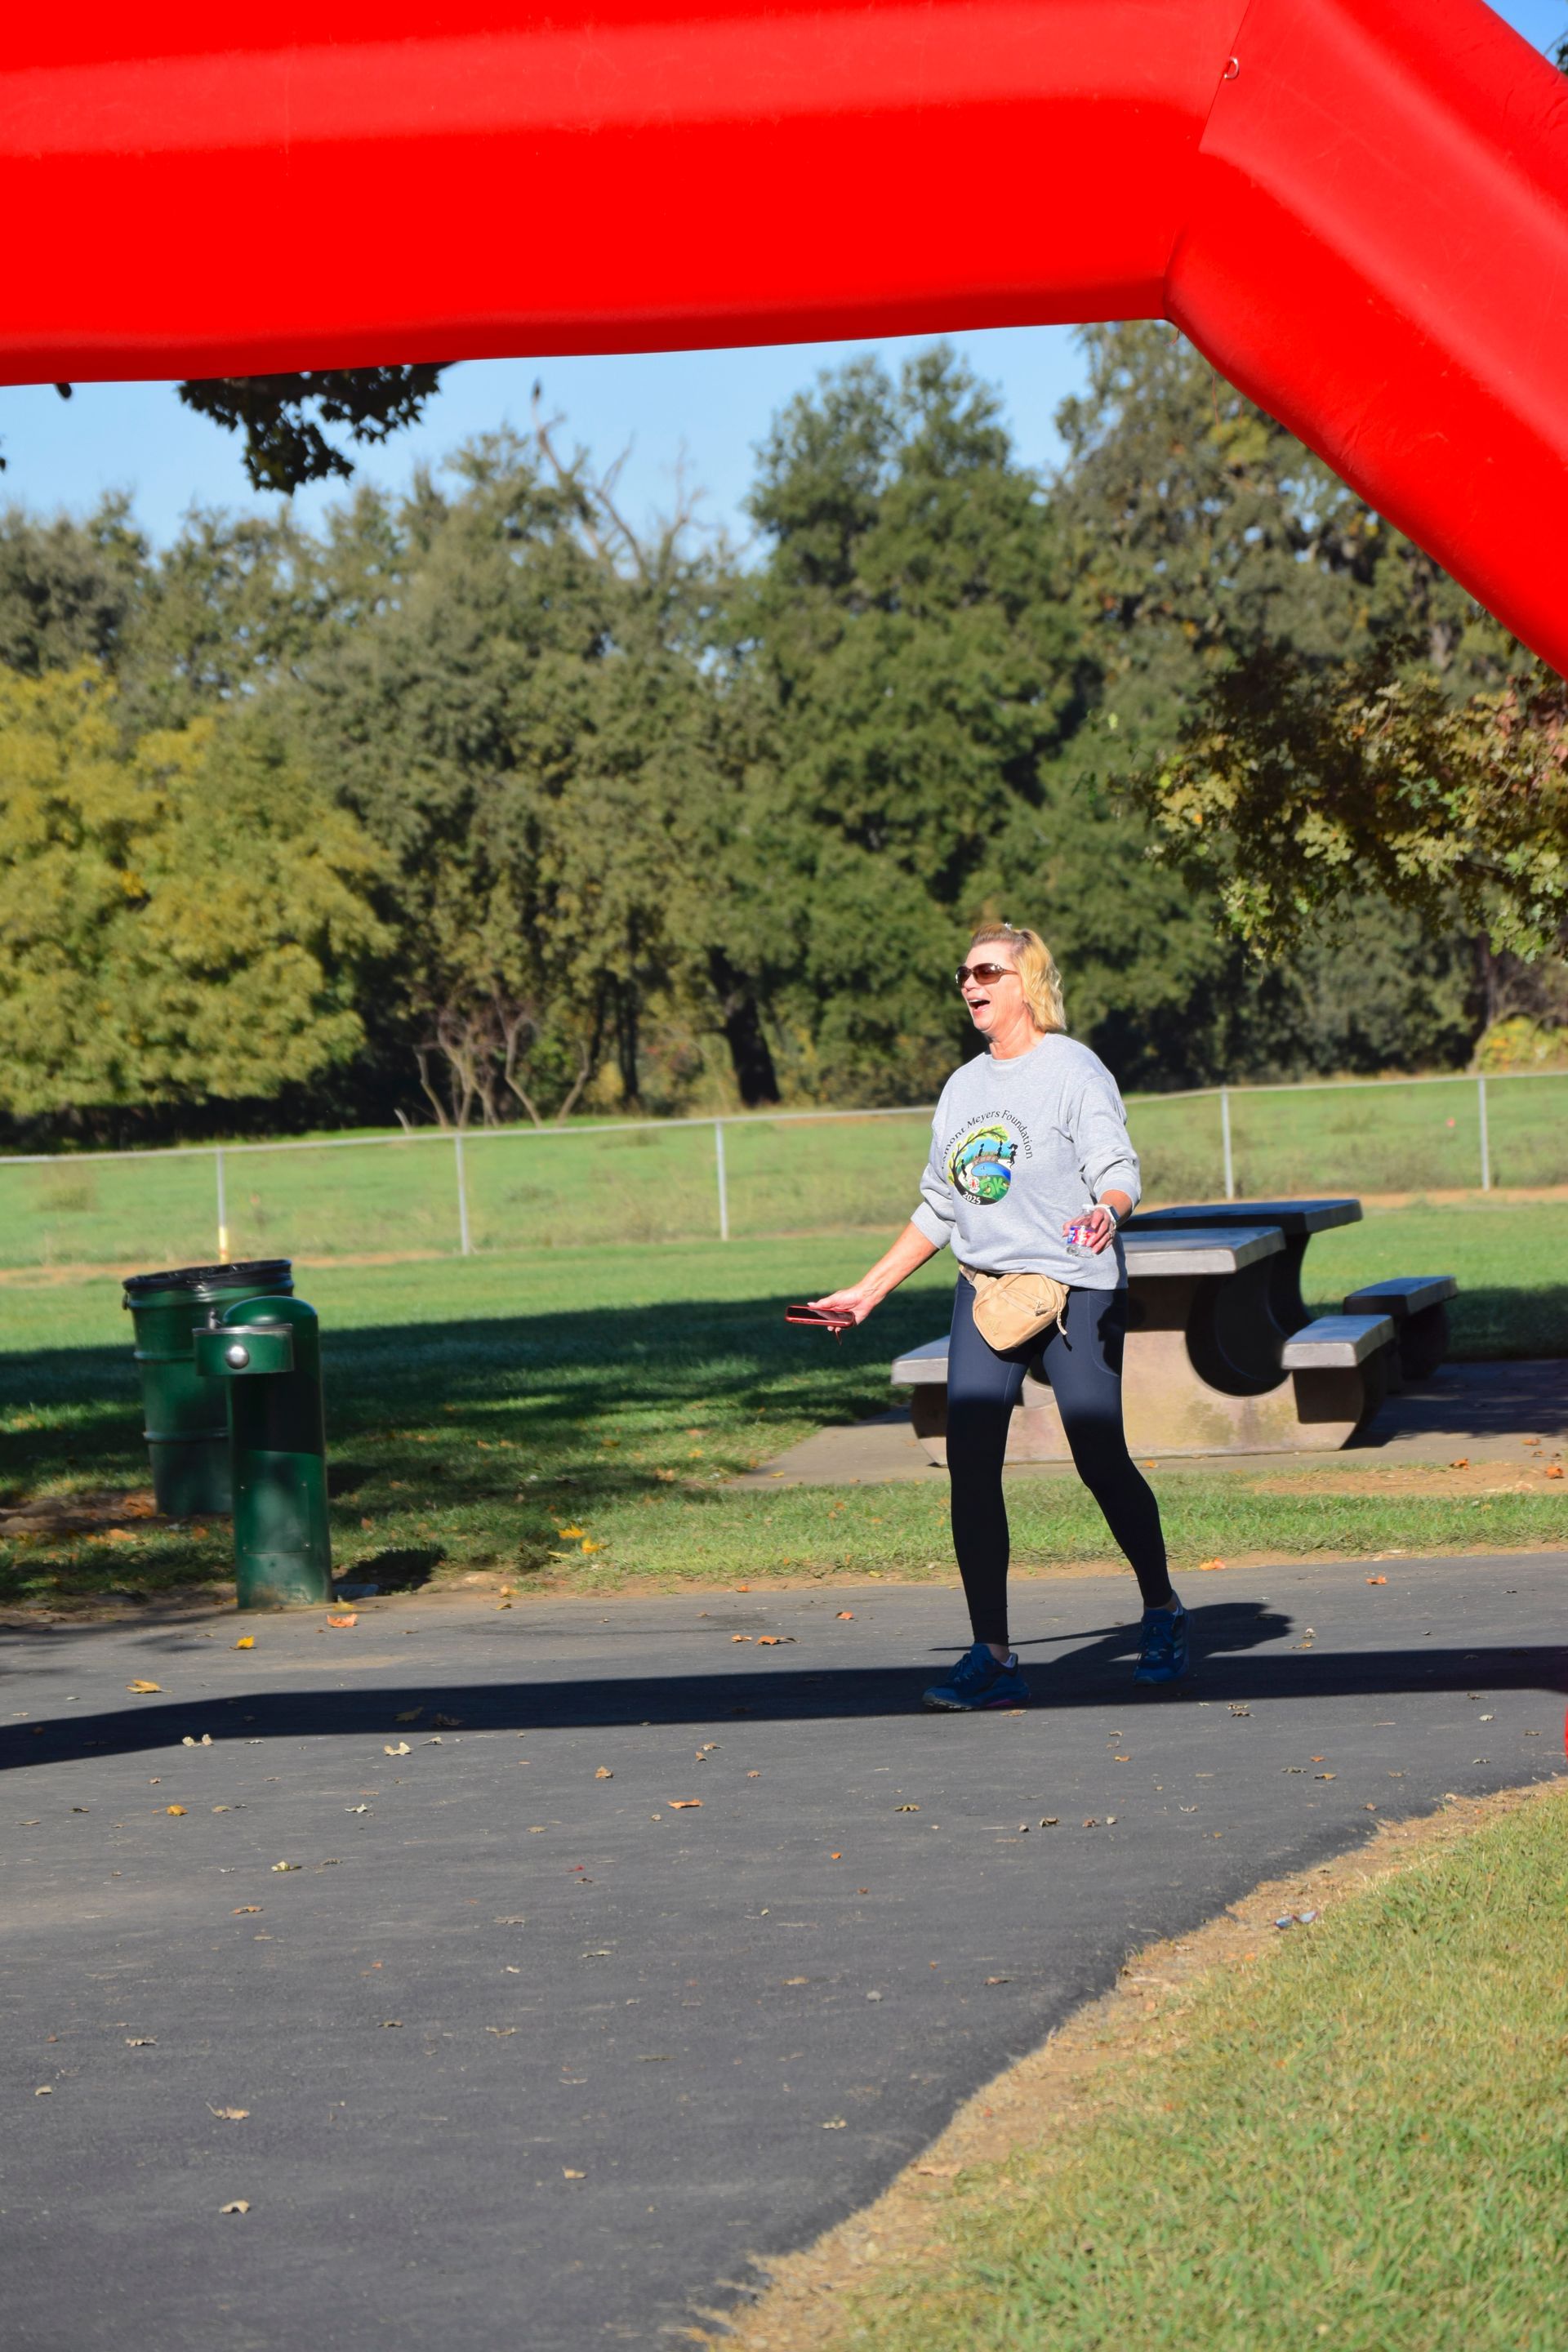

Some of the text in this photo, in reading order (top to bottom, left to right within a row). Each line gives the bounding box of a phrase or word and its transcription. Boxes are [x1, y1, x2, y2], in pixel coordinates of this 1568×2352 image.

[967, 1110, 1000, 1129] Meyers
[1001, 1109, 1033, 1160] Foundation
[962, 1191, 982, 1205] 2025
[979, 1176, 1010, 1198] 5K
